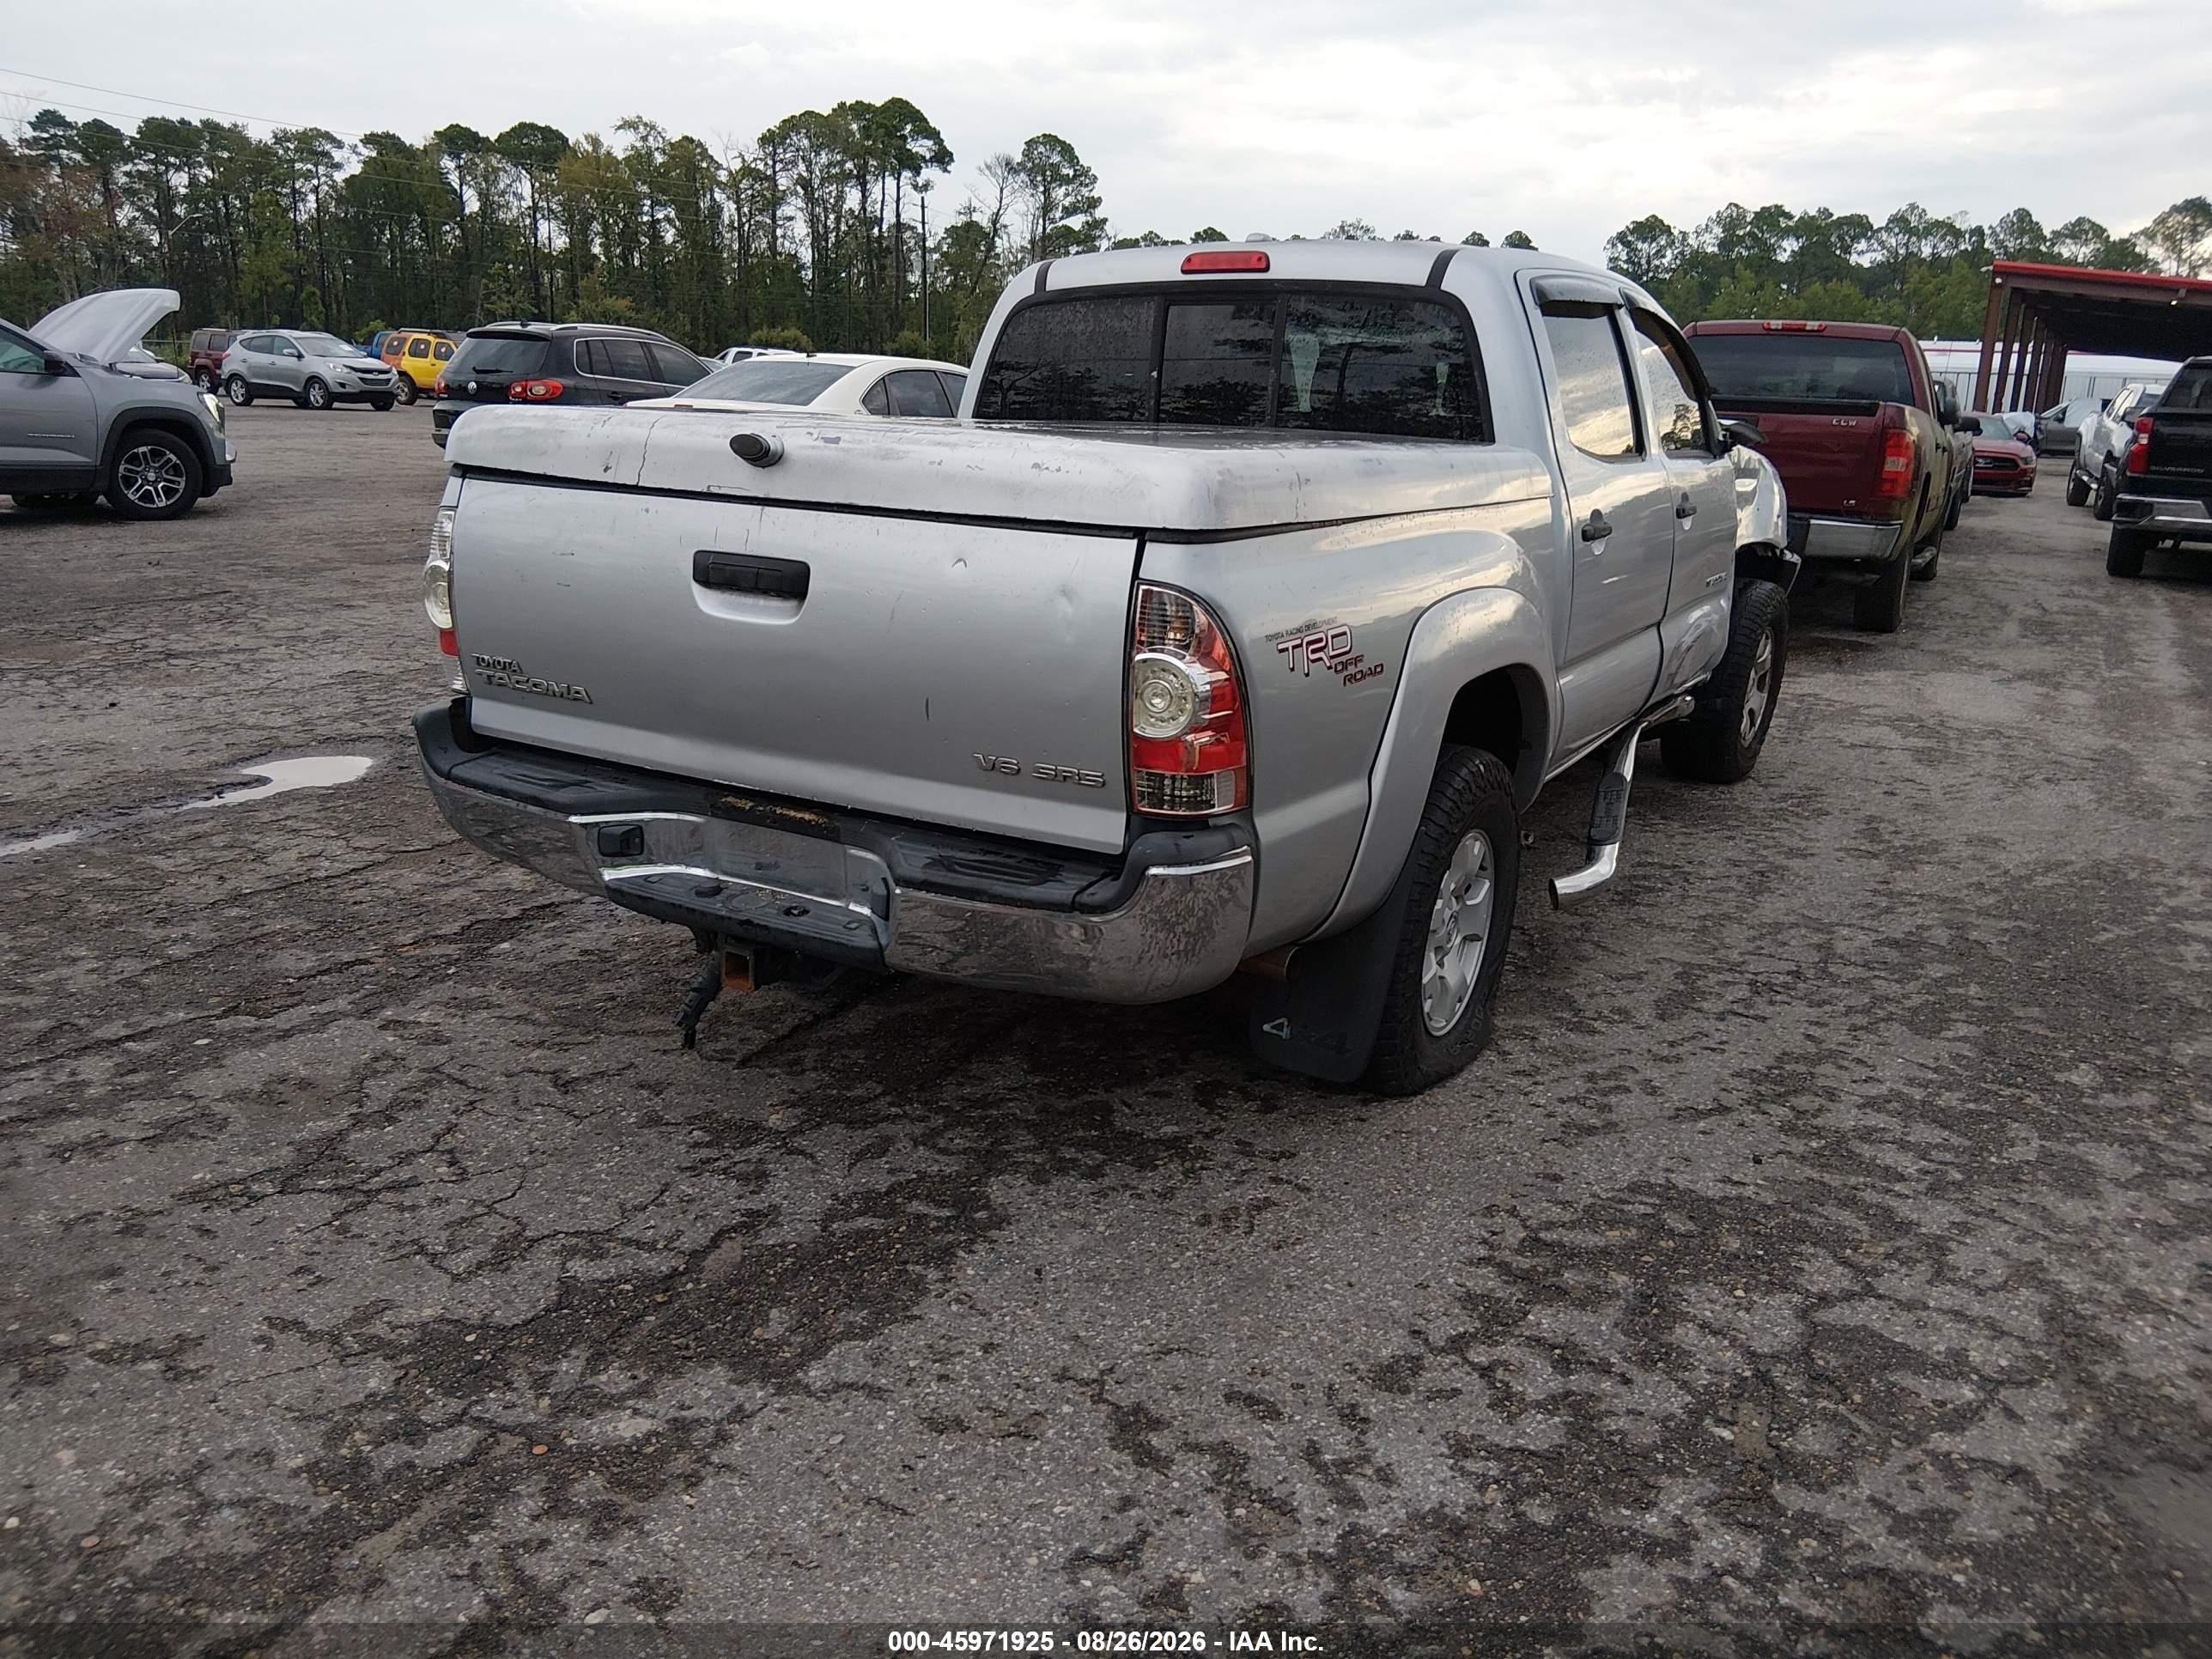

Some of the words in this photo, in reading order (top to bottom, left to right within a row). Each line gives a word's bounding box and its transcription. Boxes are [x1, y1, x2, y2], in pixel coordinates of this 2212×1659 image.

[1265, 630, 1285, 642] TOYOTA
[471, 653, 522, 673] TOYOTA
[1277, 624, 1352, 678] TRD
[1334, 654, 1364, 674] OFF
[1343, 663, 1384, 687] ROAD
[475, 669, 592, 704] TACOMA
[973, 753, 1021, 775] V6
[1031, 763, 1105, 787] SR5
